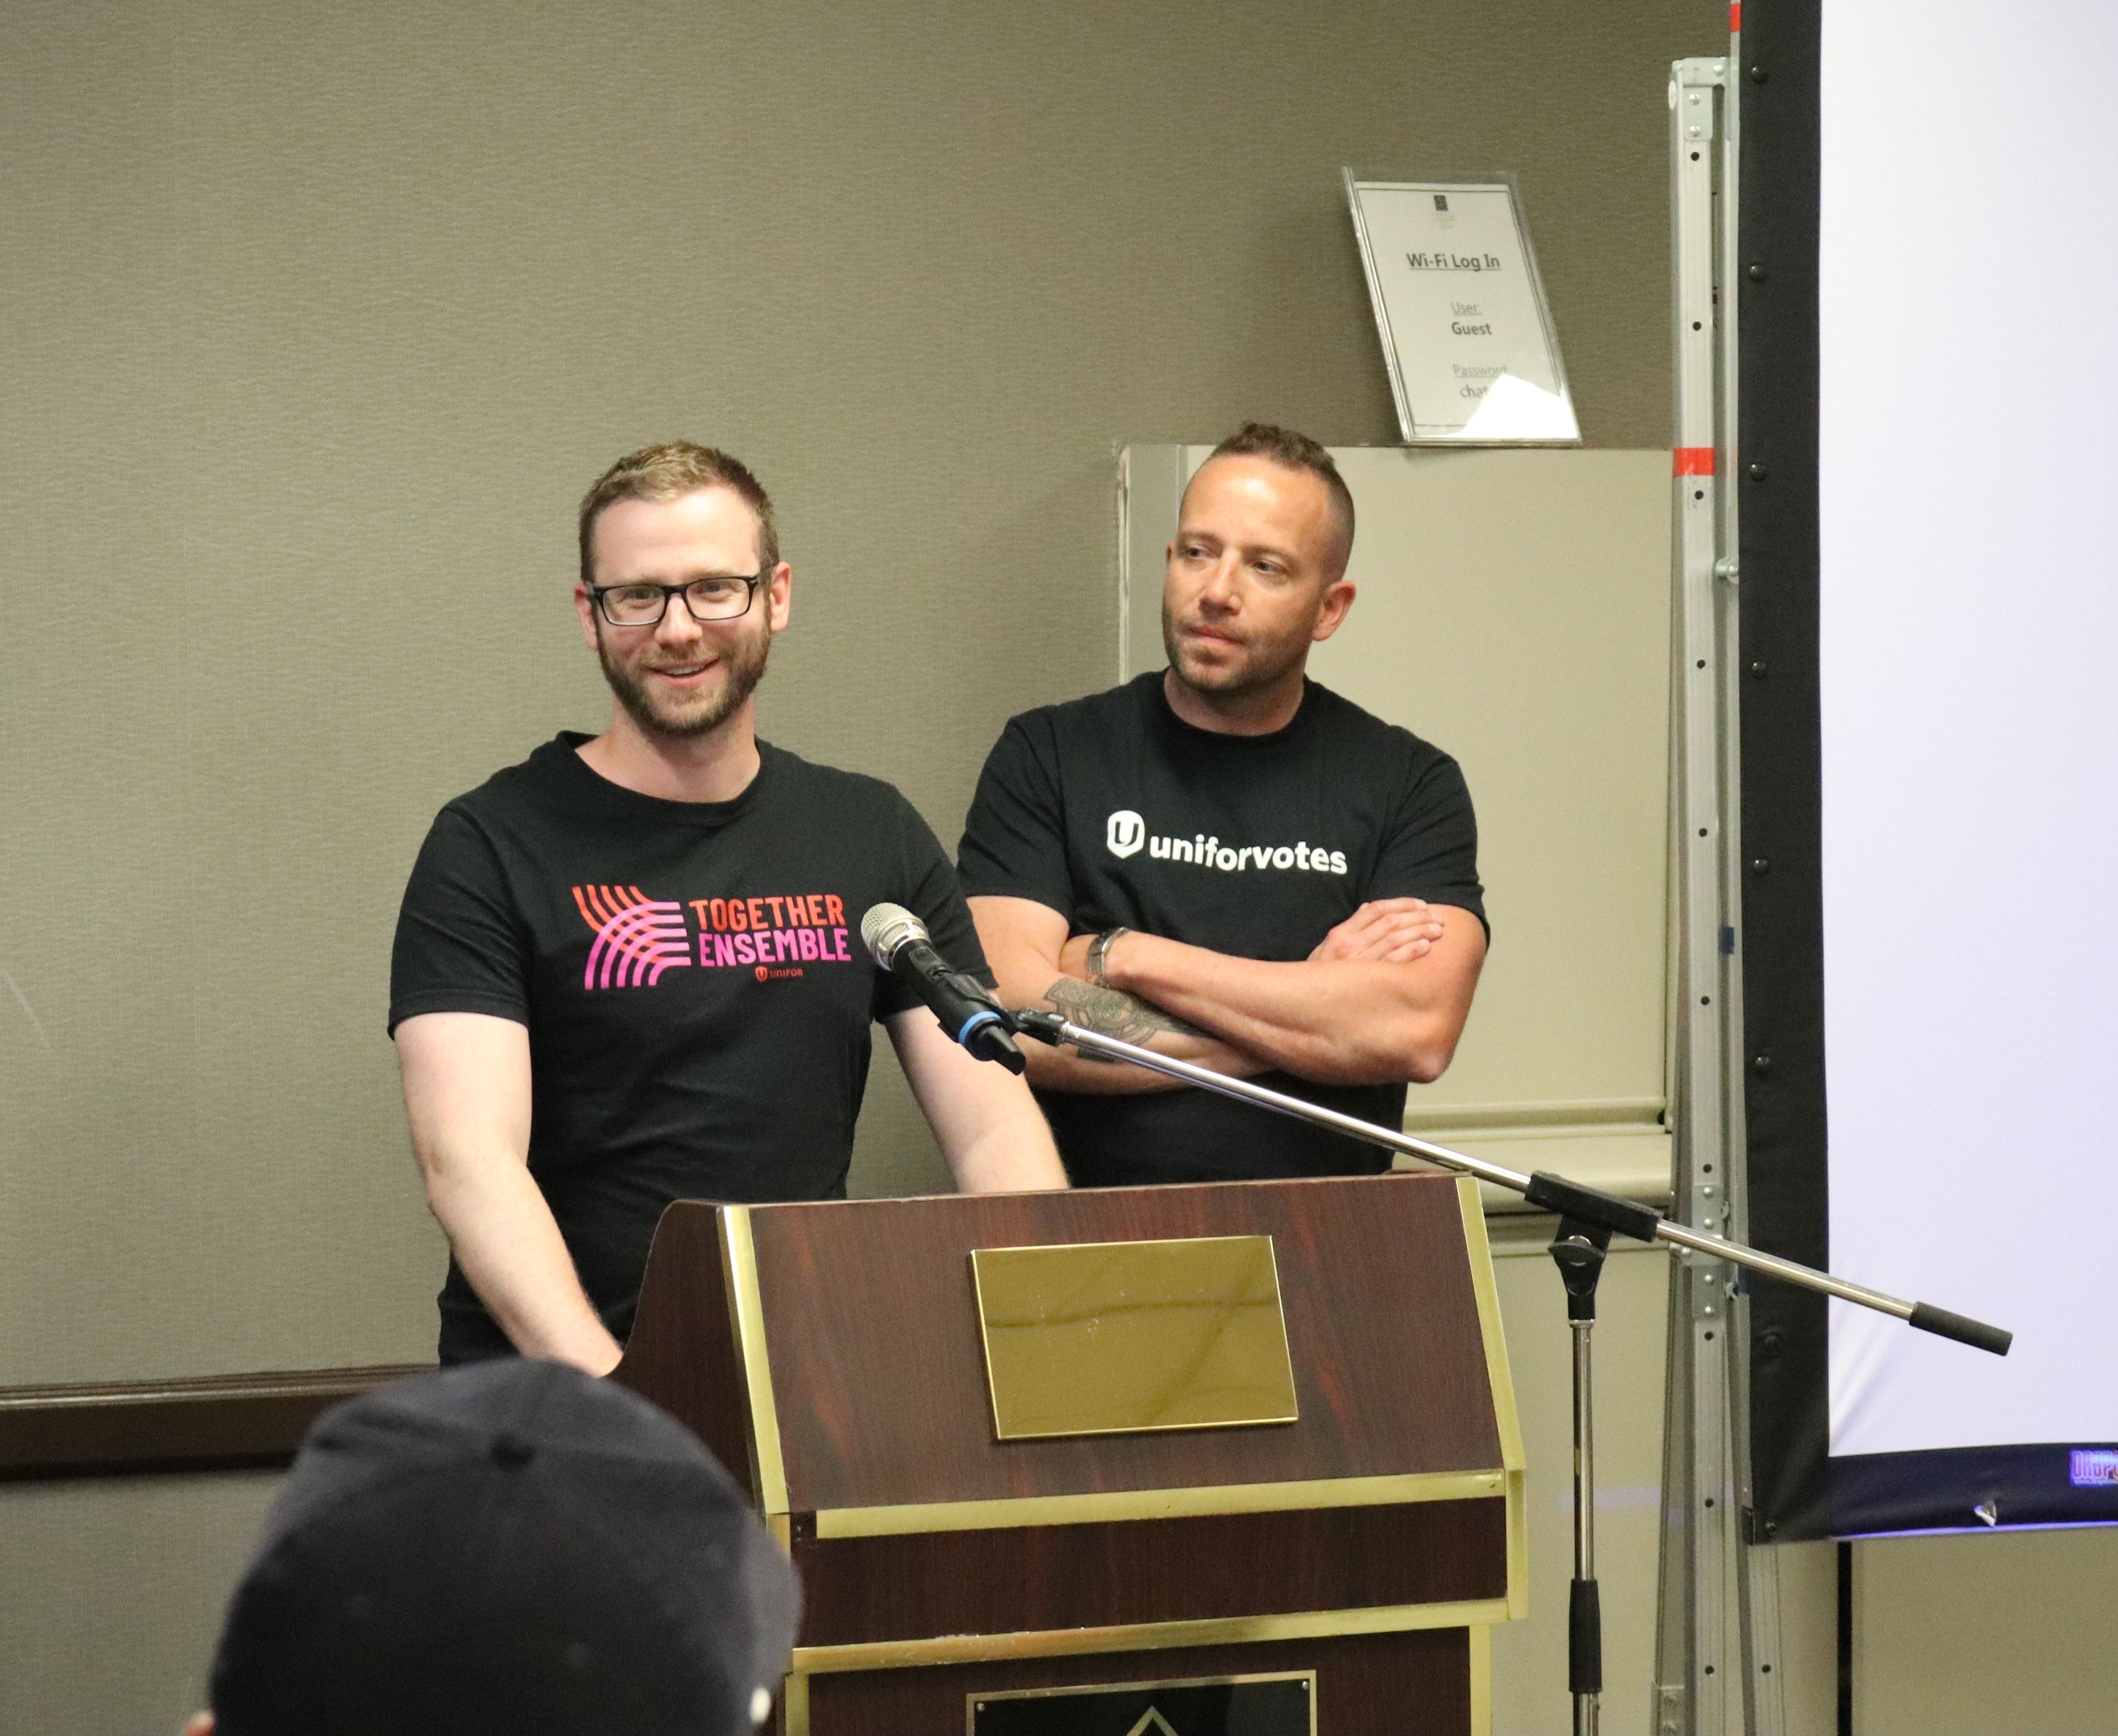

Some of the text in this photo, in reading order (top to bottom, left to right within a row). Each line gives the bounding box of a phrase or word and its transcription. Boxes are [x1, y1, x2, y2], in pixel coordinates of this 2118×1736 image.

[1406, 253, 1500, 272] Wi-Fi Log In
[1451, 322, 1492, 335] Guest
[1150, 834, 1348, 874] uniforvotes
[689, 895, 847, 932] TOGETHER
[700, 928, 852, 967] ENSEMBLE
